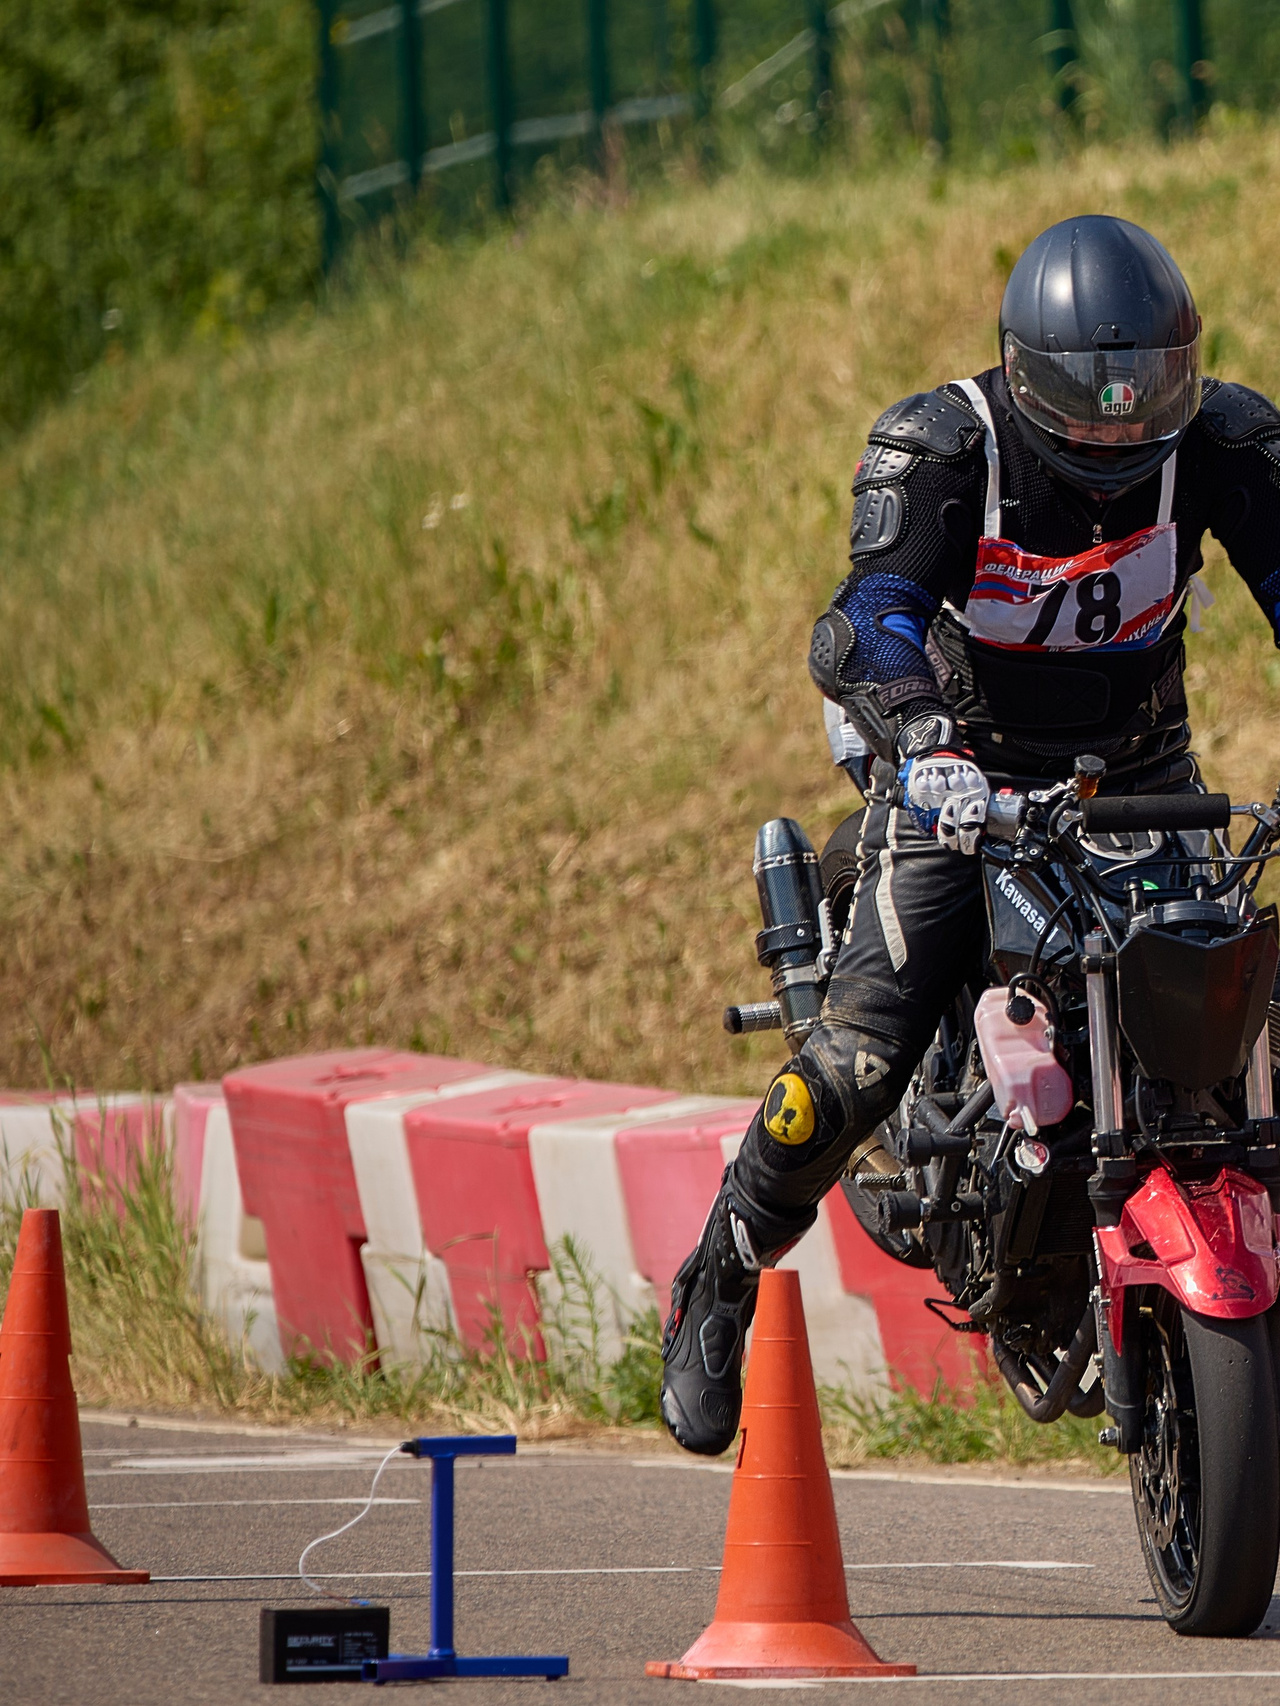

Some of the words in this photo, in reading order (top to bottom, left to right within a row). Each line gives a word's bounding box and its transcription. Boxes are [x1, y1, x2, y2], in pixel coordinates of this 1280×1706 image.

[1103, 402, 1132, 415] agv
[1023, 571, 1121, 644] 78
[995, 868, 1059, 943] Kawasai
